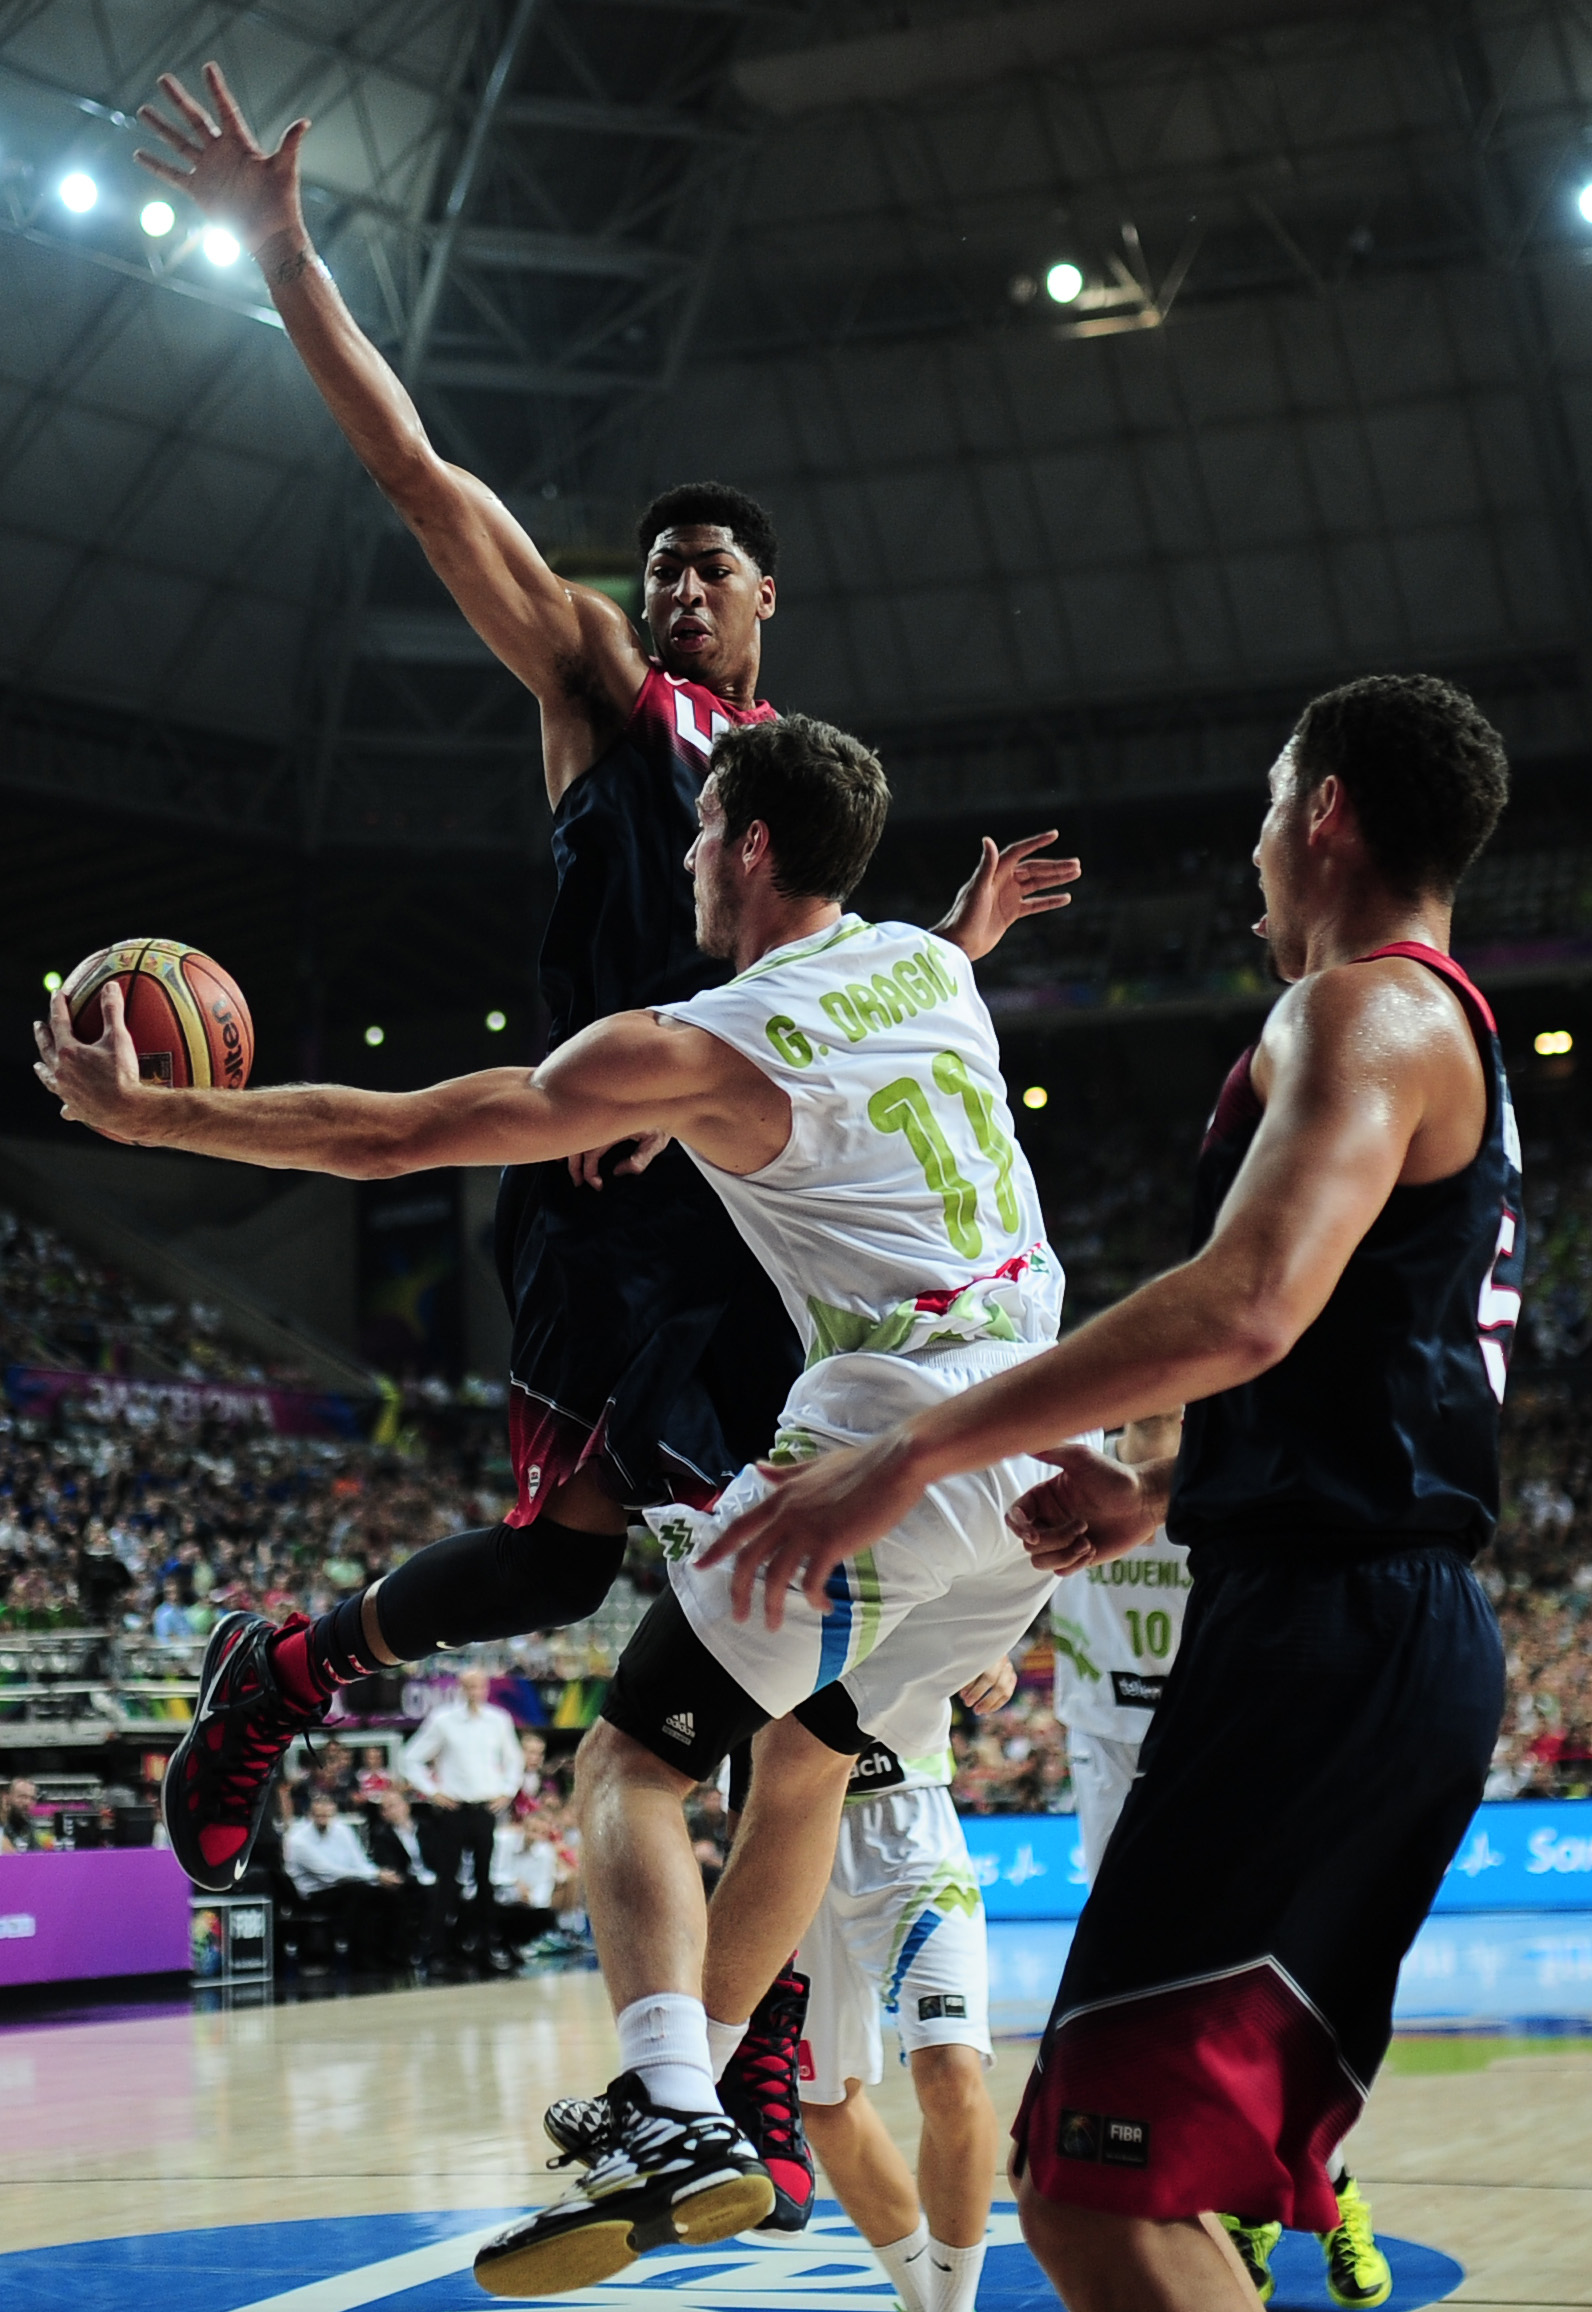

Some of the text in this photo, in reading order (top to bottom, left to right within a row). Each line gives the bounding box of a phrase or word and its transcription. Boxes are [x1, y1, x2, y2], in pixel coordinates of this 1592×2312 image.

[212, 999, 244, 1090] olten
[765, 1014, 829, 1069] G.
[867, 1050, 1020, 1261] 11
[1125, 1609, 1171, 1659] 10
[665, 1716, 696, 1738] adidas
[848, 1752, 892, 1780] ach
[1109, 2123, 1143, 2143] FIBA
